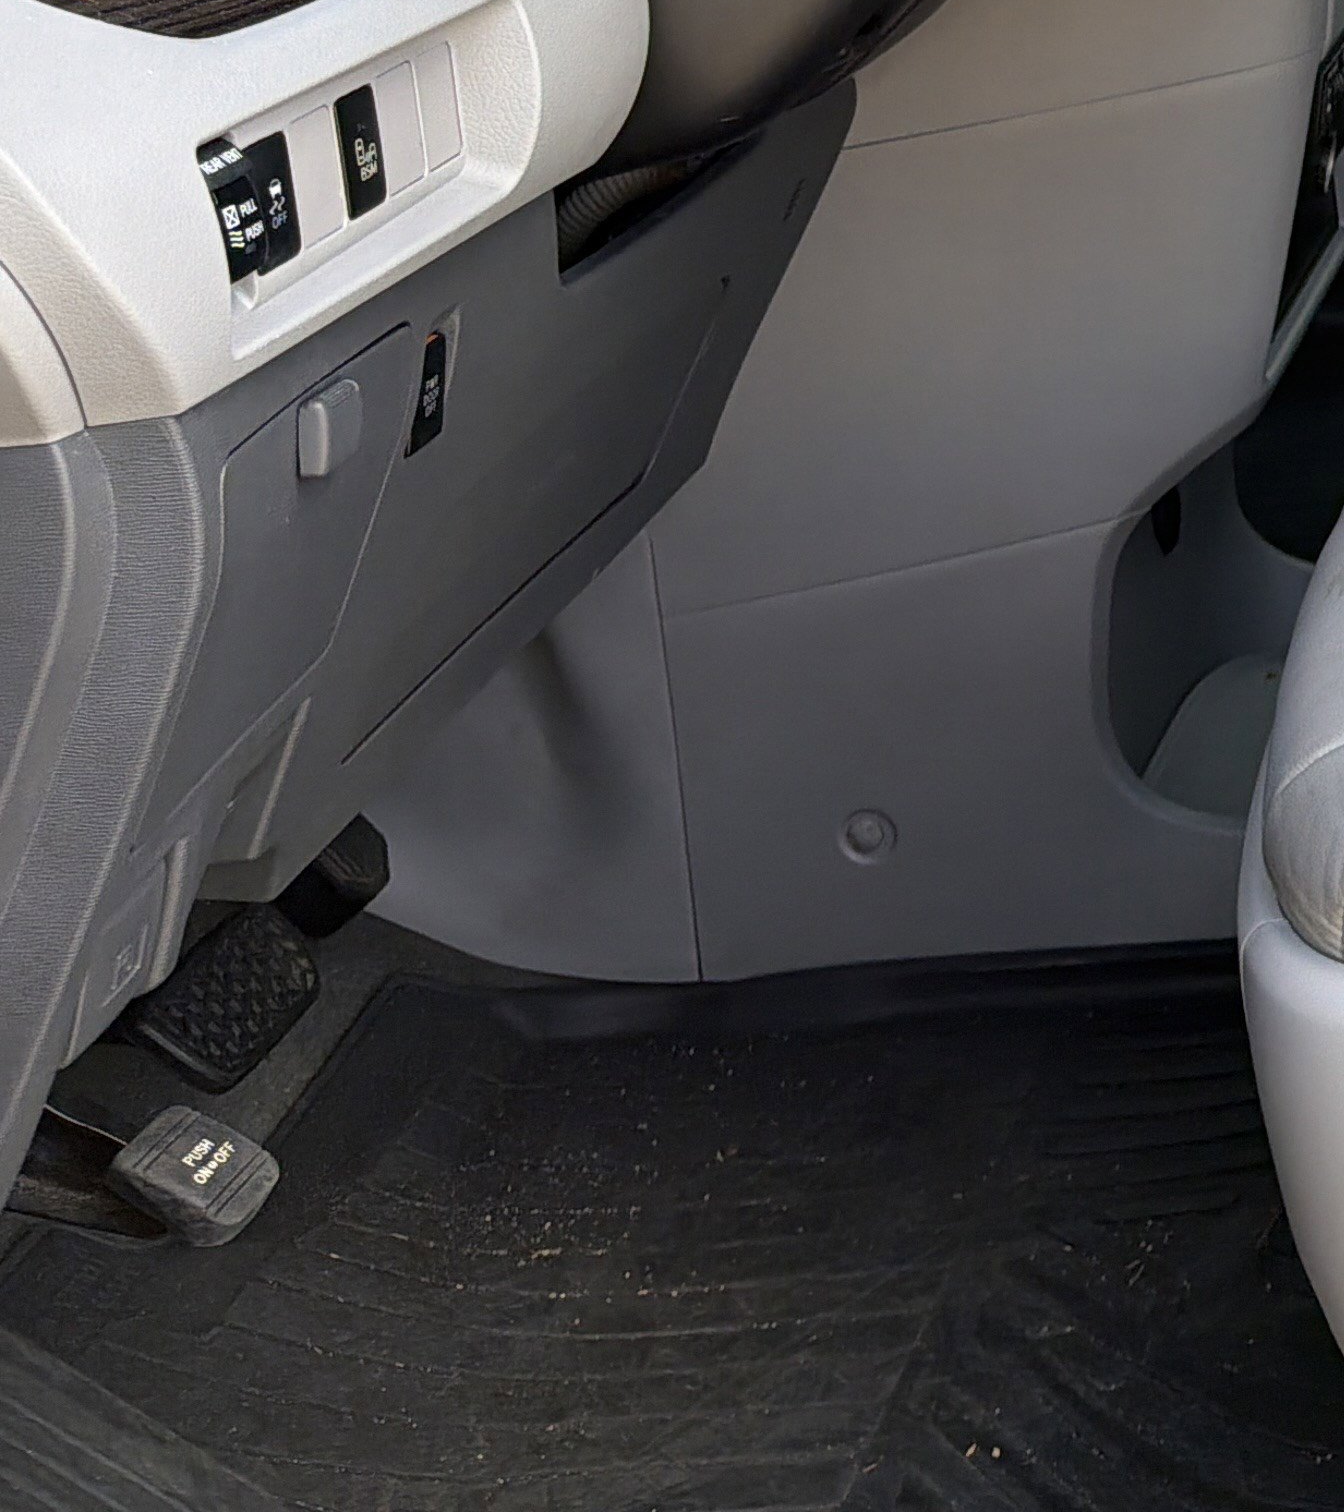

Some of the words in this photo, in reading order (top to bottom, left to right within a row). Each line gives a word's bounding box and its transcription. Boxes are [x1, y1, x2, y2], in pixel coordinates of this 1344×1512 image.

[240, 197, 258, 218] PULL
[272, 209, 288, 229] OFF
[182, 1139, 215, 1167] PUSH
[194, 1167, 214, 1184] ON
[214, 1141, 235, 1162] OFF
